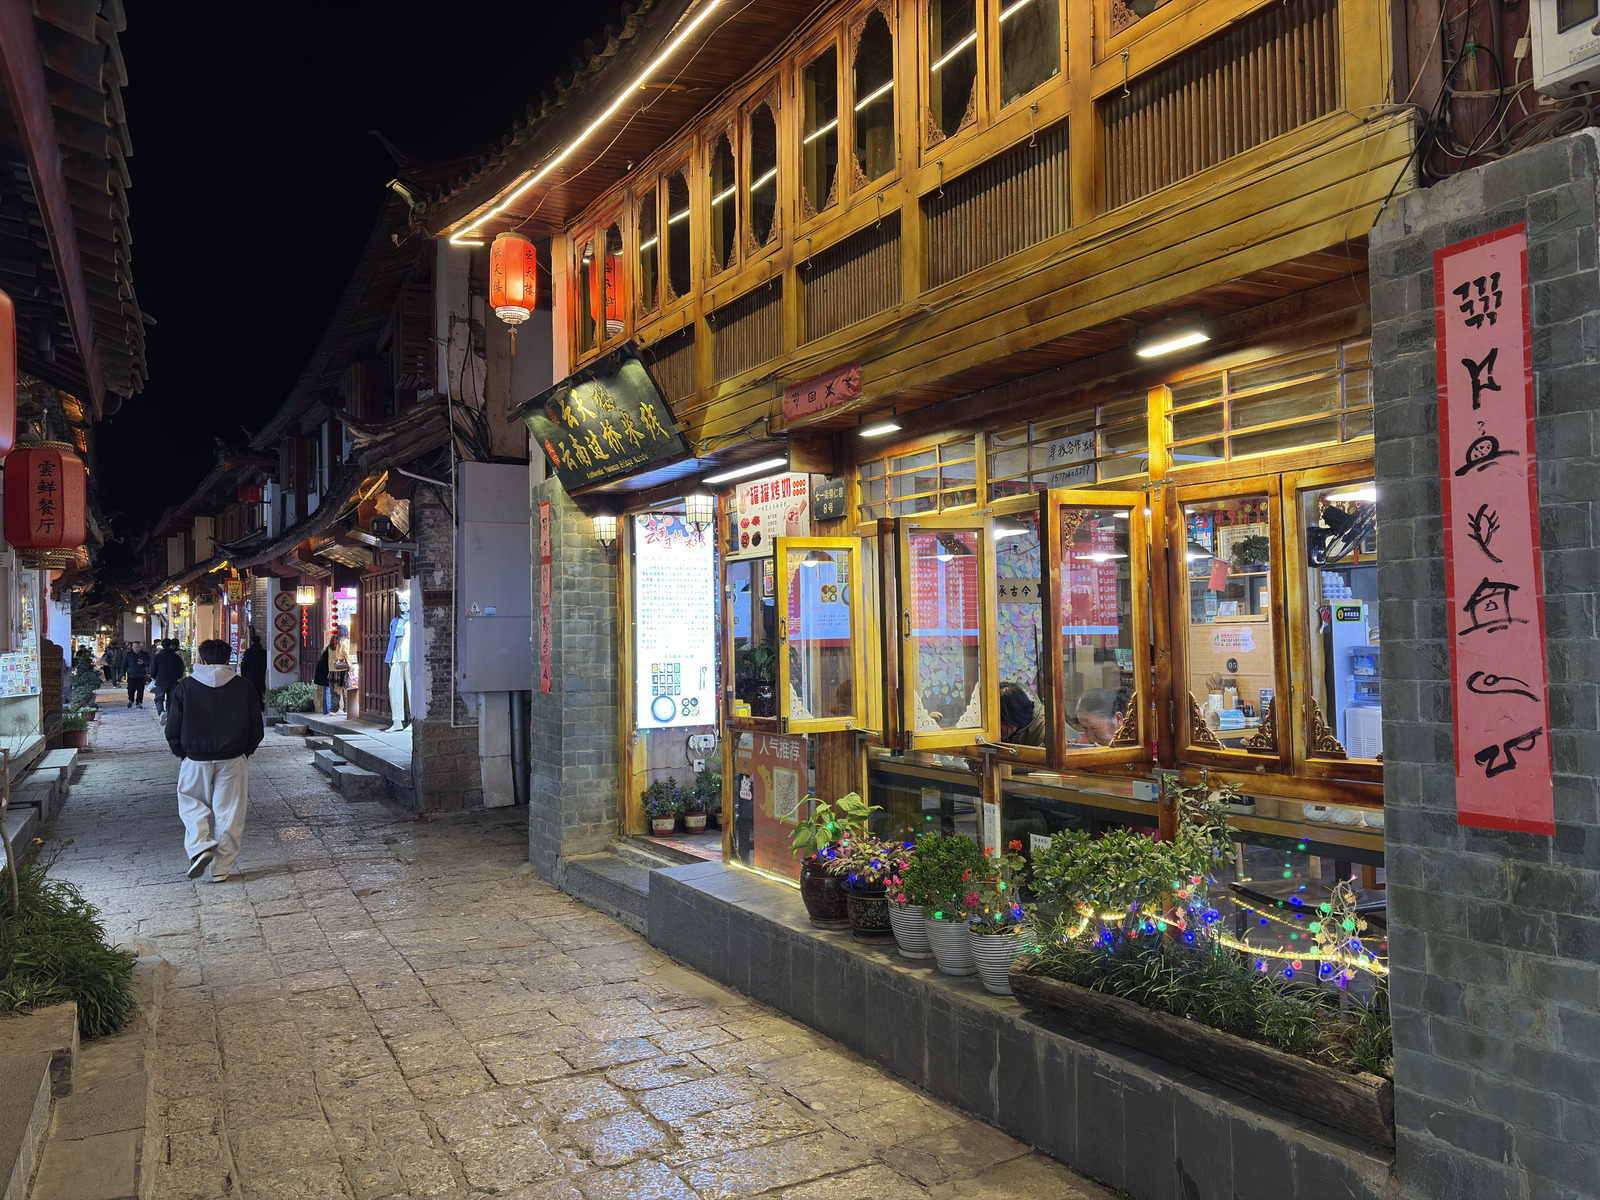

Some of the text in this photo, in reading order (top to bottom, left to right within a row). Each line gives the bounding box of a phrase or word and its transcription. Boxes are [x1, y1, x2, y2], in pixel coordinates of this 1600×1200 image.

[558, 402, 670, 470] 云南过桥米线
[35, 460, 57, 535] 雲鲜餐厅
[749, 477, 791, 506] 罐罐烤奶
[823, 502, 834, 514] 8号
[1228, 661, 1237, 669] 05
[759, 735, 800, 761] 人气推荐
